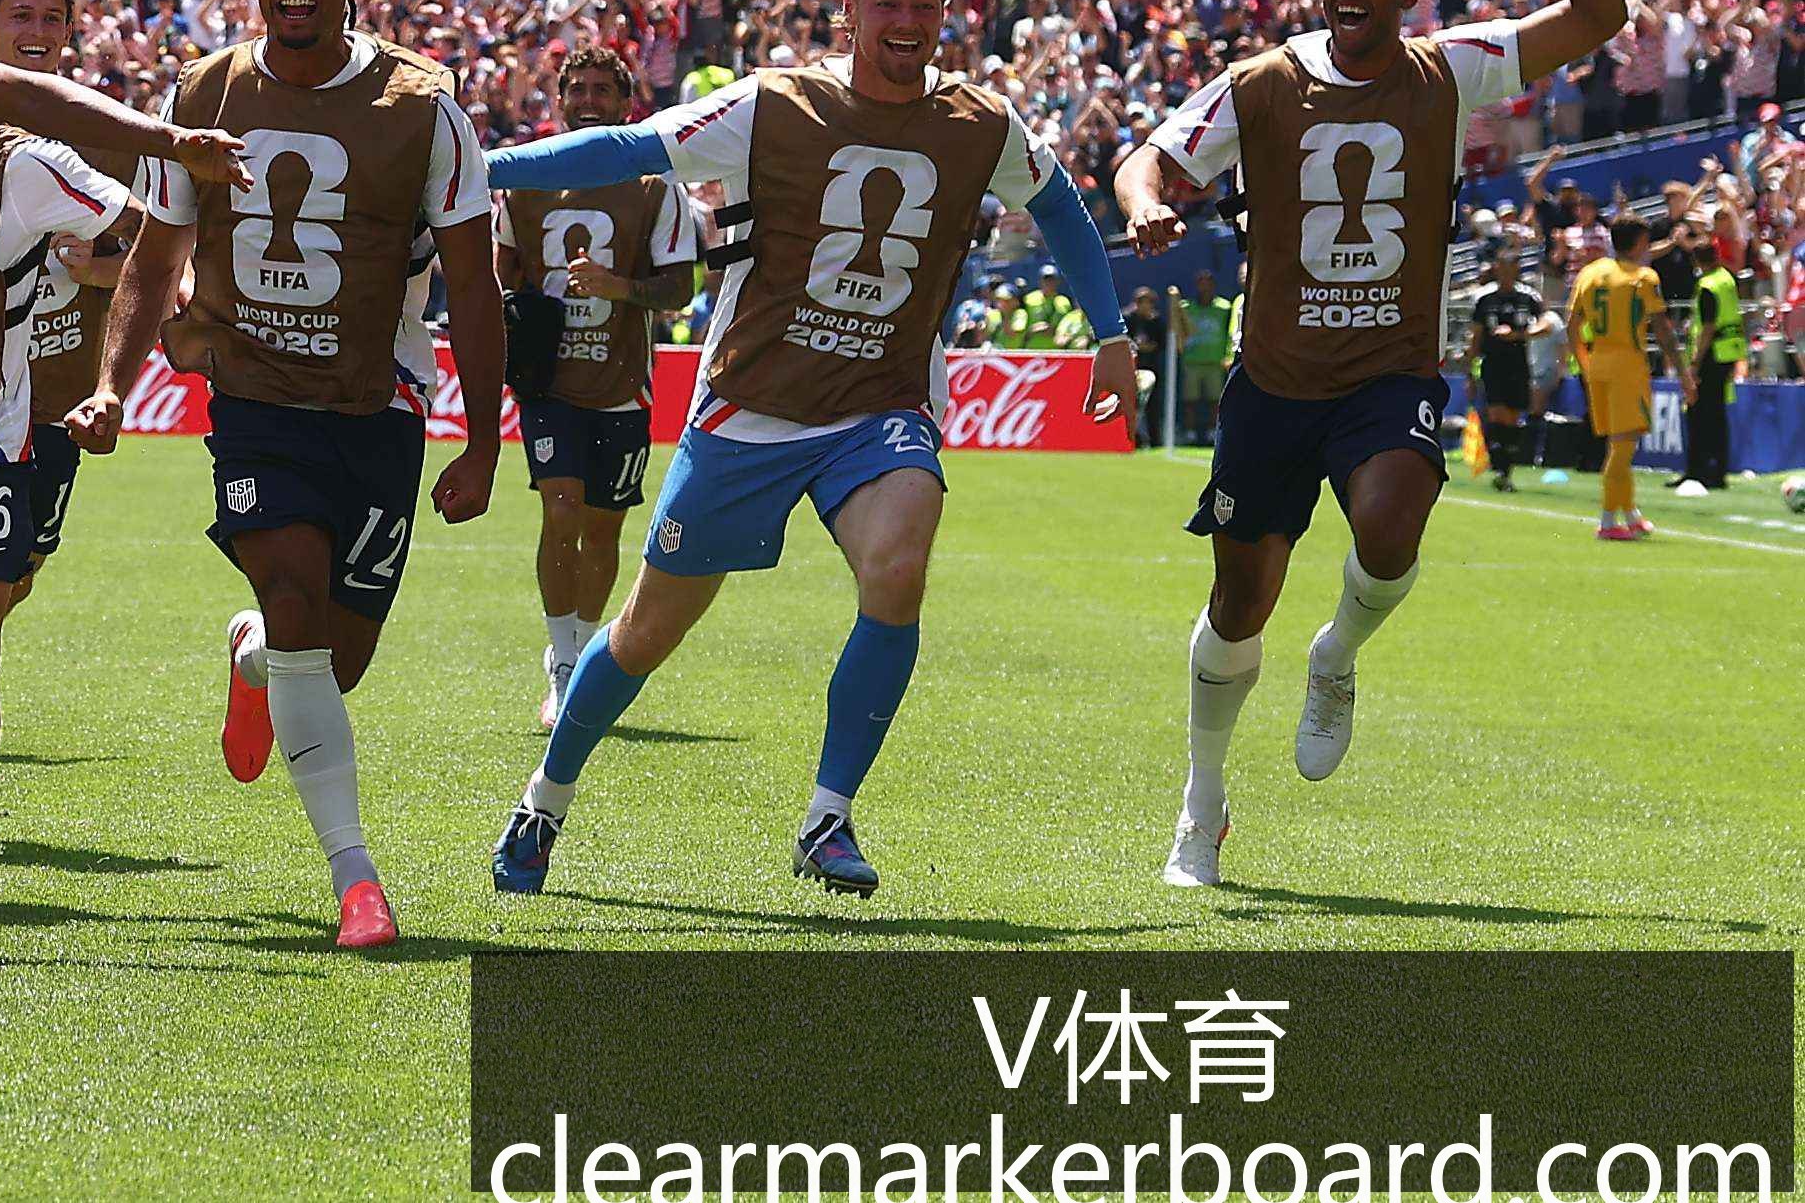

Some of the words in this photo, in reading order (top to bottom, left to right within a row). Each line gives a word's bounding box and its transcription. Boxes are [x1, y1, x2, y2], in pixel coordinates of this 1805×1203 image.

[1330, 251, 1379, 269] FIFA
[258, 268, 310, 291] FIFA
[834, 276, 884, 303] FIFA
[1300, 285, 1365, 302] WORLD
[1367, 286, 1402, 302] CUP
[52, 310, 82, 331] CUP
[235, 302, 297, 328] WORLD
[299, 314, 341, 330] CUP
[795, 306, 860, 333] WORLD
[861, 319, 896, 336] CUP
[1297, 303, 1402, 329] 2026
[584, 331, 611, 342] CUP
[782, 323, 886, 360] 2026
[557, 342, 609, 362] 026
[1417, 398, 1436, 432] 6
[615, 446, 646, 490] 10
[344, 506, 408, 579] 12
